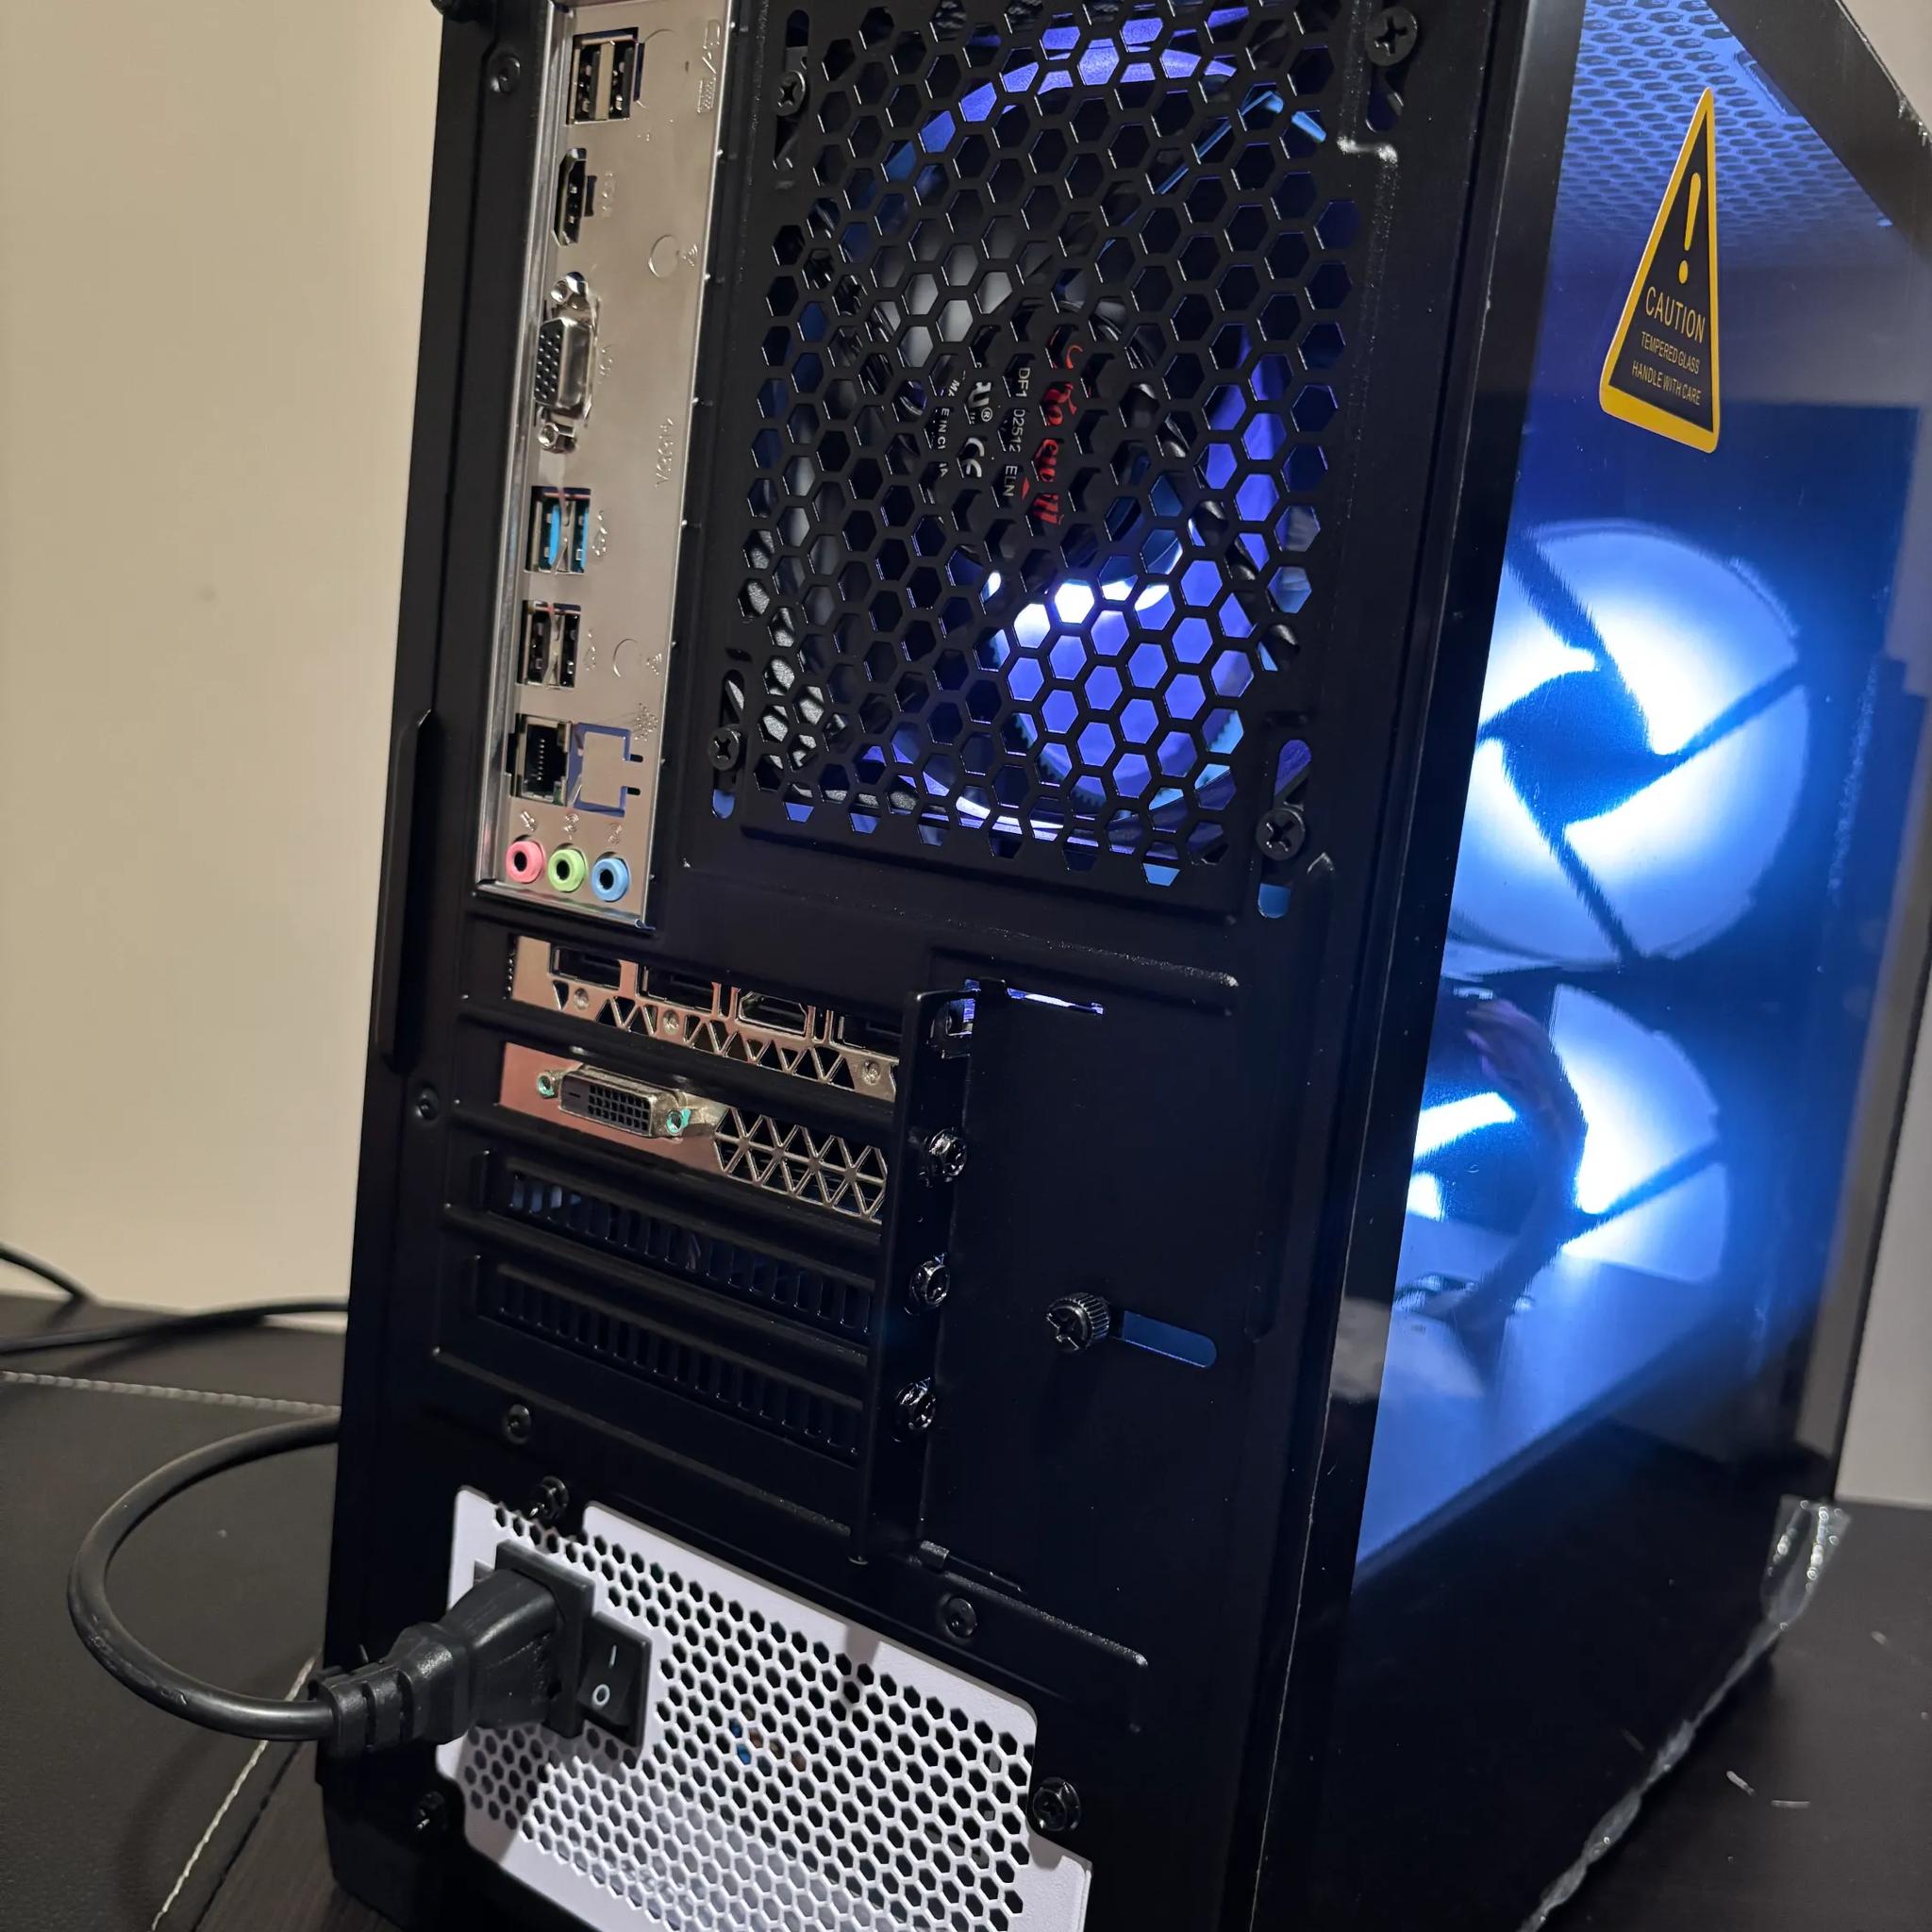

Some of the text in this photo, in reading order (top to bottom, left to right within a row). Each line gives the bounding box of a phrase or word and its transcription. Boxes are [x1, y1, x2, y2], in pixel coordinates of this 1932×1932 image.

[1645, 286, 1706, 344] CAUTION
[1641, 331, 1701, 375] TEMPERED GLASS
[1631, 360, 1702, 406] HANDLE WITH CARE
